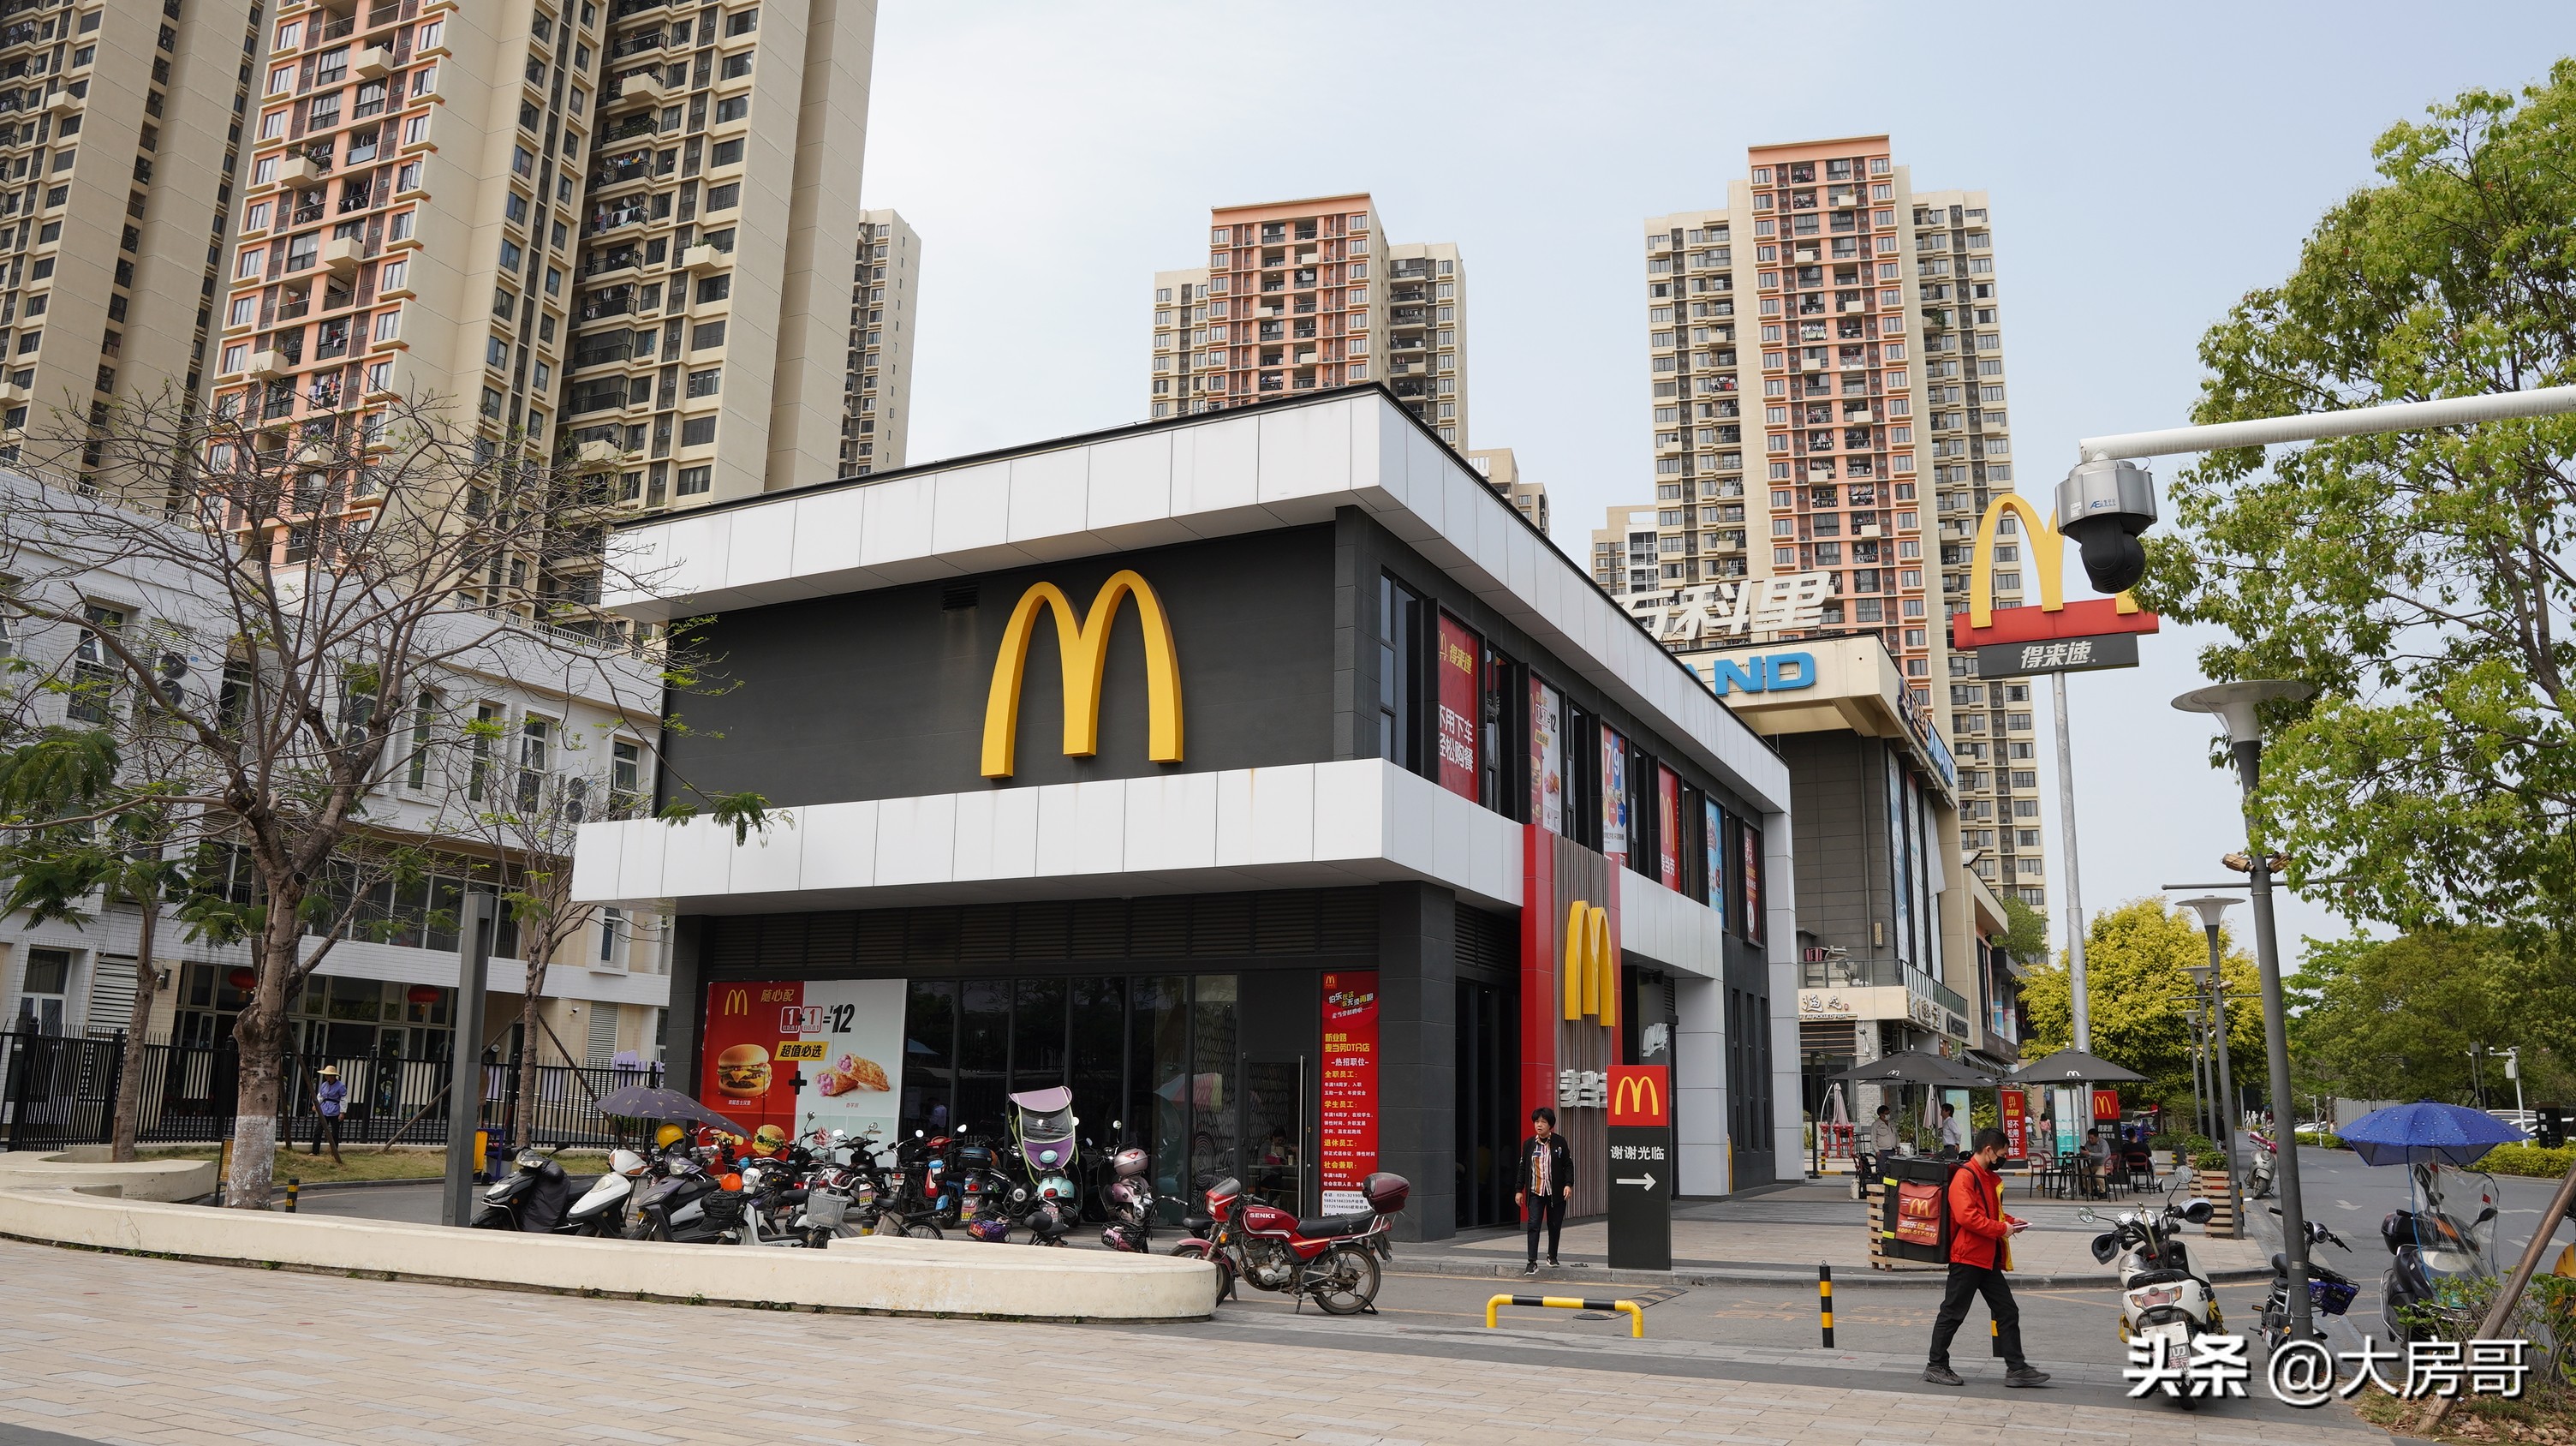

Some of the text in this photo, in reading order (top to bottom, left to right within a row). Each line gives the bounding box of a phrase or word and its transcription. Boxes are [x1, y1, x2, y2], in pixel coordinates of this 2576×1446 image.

[1449, 643, 1473, 675] 得来速
[1685, 652, 1816, 696] ND
[760, 989, 795, 1002] 随心配
[779, 1044, 823, 1058] 超值必选
[1610, 1145, 1665, 1161] 谢谢光临
